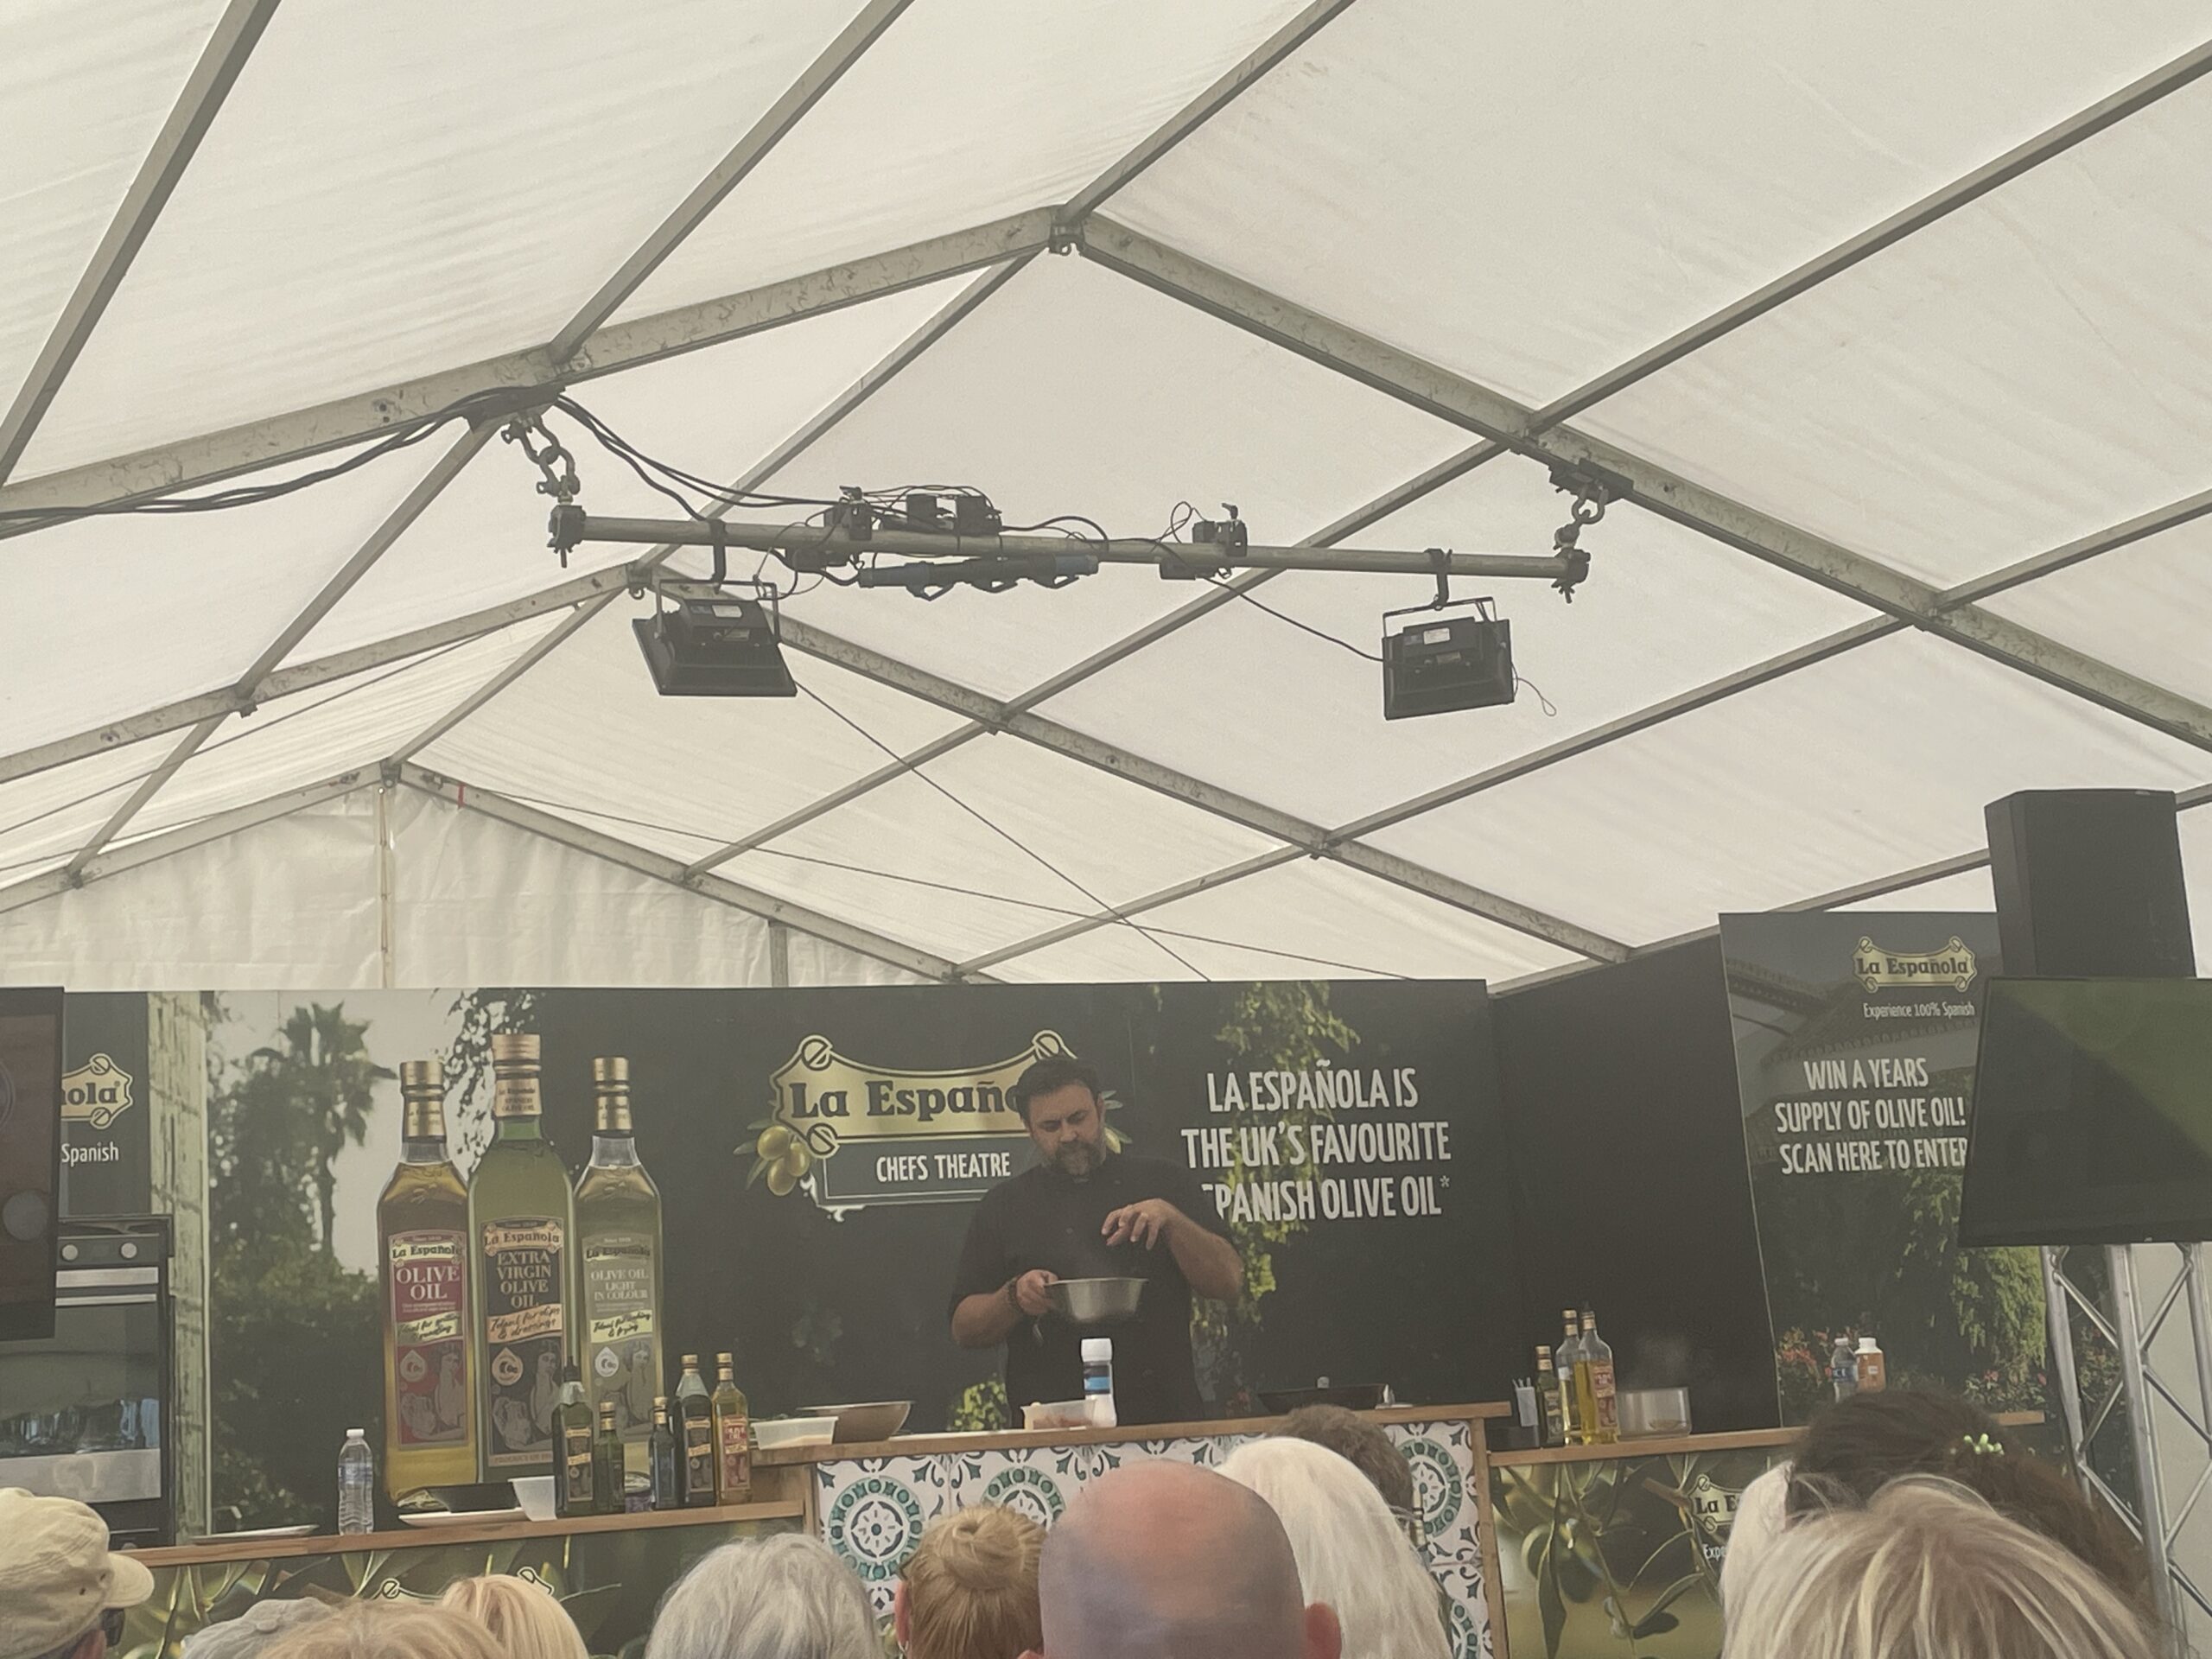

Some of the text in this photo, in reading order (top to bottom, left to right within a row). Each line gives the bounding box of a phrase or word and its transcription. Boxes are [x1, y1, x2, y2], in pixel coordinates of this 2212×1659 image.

[1856, 956, 1969, 977] La Española
[1863, 1001, 1975, 1020] Experience 100% Spanish
[1206, 1058, 1419, 1112] LA ESPAÑOLA IS
[1803, 1058, 1929, 1090] WIN A YEARS
[61, 1082, 118, 1106] ola
[789, 1082, 850, 1119] La
[1775, 1096, 1967, 1133] SUPPLY OF OLIVE OIL!
[60, 1141, 119, 1167] Spanish
[1180, 1121, 1452, 1168] THE UK'S FAVOURITE
[876, 1152, 1011, 1182] CHEFS THEATRE
[1779, 1142, 1834, 1175] SCAN
[1835, 1141, 1883, 1171] HERE
[1884, 1139, 1910, 1169] TO
[1201, 1180, 1316, 1223] PANISH
[1321, 1177, 1396, 1220] OLIVE
[498, 1250, 551, 1266] EXTRA
[396, 1265, 461, 1285] OLIVE
[497, 1265, 552, 1279] VIRGIN
[410, 1283, 448, 1300] OIL
[500, 1279, 549, 1294] OLIVE
[511, 1294, 539, 1308] OIL
[1694, 1497, 1719, 1515] La
